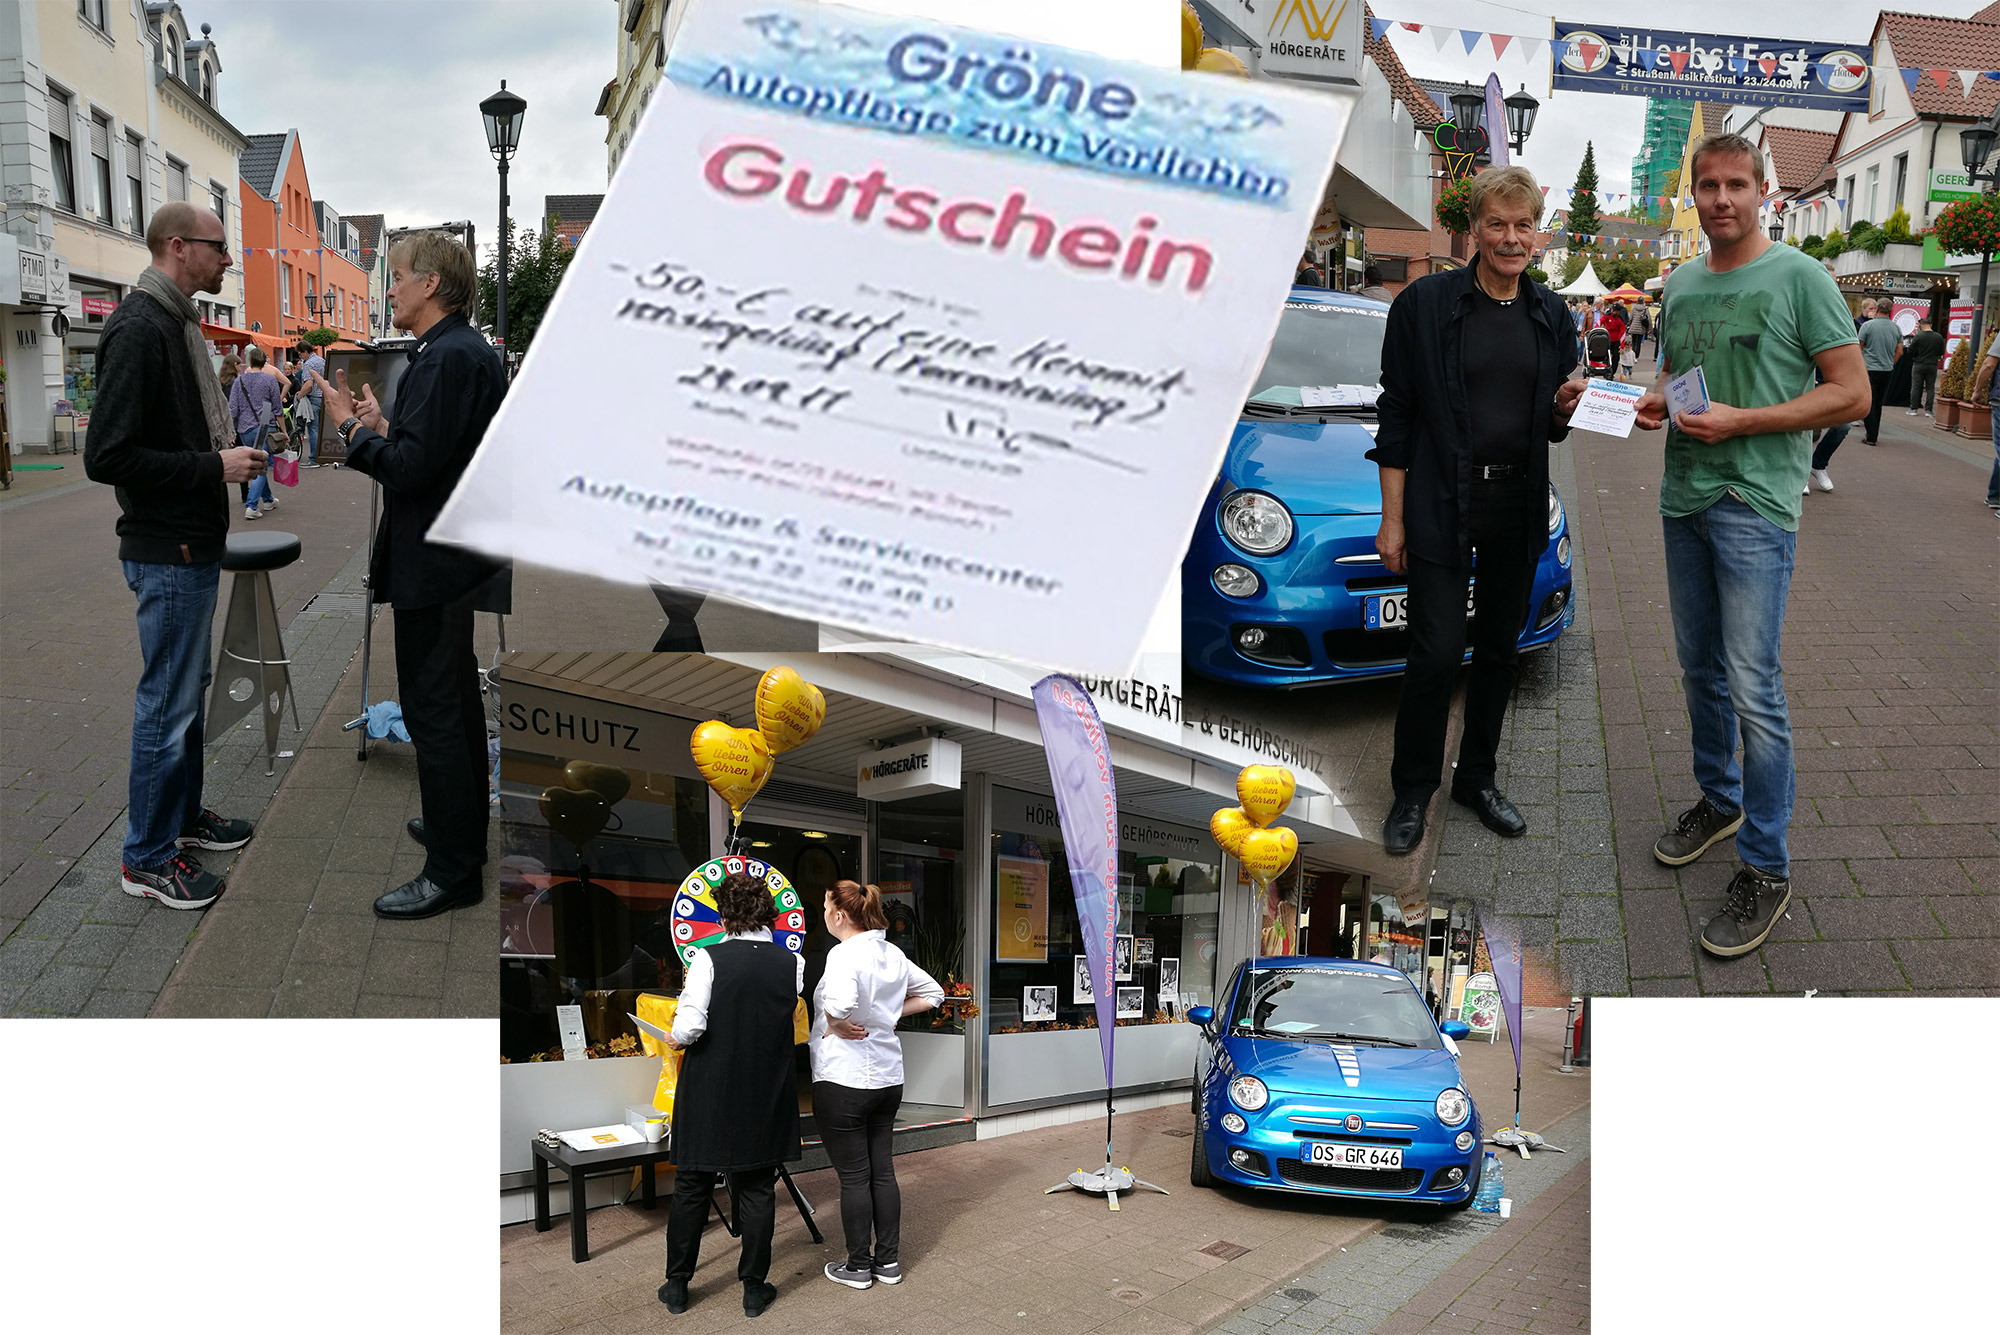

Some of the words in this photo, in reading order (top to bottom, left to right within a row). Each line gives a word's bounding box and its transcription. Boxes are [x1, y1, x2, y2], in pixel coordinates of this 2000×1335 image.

[1270, 40, 1346, 62] HÖRGERÄTE
[887, 32, 1140, 121] Gröne
[1621, 83, 1709, 97] Herrliches
[1721, 91, 1804, 105] Herforder
[705, 64, 953, 136] Autopflege
[968, 116, 1062, 158] zum
[1080, 135, 1291, 200] Verlieben
[703, 141, 1217, 293] Gutschein
[21, 256, 44, 277] PTMD
[1590, 390, 1635, 405] Gutschein
[560, 474, 763, 529] Autopflege
[812, 524, 1064, 595] Servicecenter
[781, 699, 810, 723] lieben
[774, 710, 805, 734] Ohren
[1219, 714, 1323, 775] GEHÖRSCHUTZ
[712, 748, 750, 763] lieben
[711, 760, 750, 776] Ohren
[872, 753, 929, 778] HÖRGERÄTE
[728, 863, 741, 871] 10
[751, 865, 762, 876] 11
[691, 882, 700, 891] 8
[770, 875, 782, 888] 12
[681, 903, 690, 912] 7
[784, 893, 794, 906] 13
[791, 914, 799, 927] 14
[789, 936, 798, 949] 15
[687, 950, 696, 958] 5
[1275, 967, 1379, 979] www.autogroene.de
[1313, 1145, 1335, 1161] OS
[1345, 1148, 1366, 1164] GR
[1370, 1149, 1400, 1166] 646
